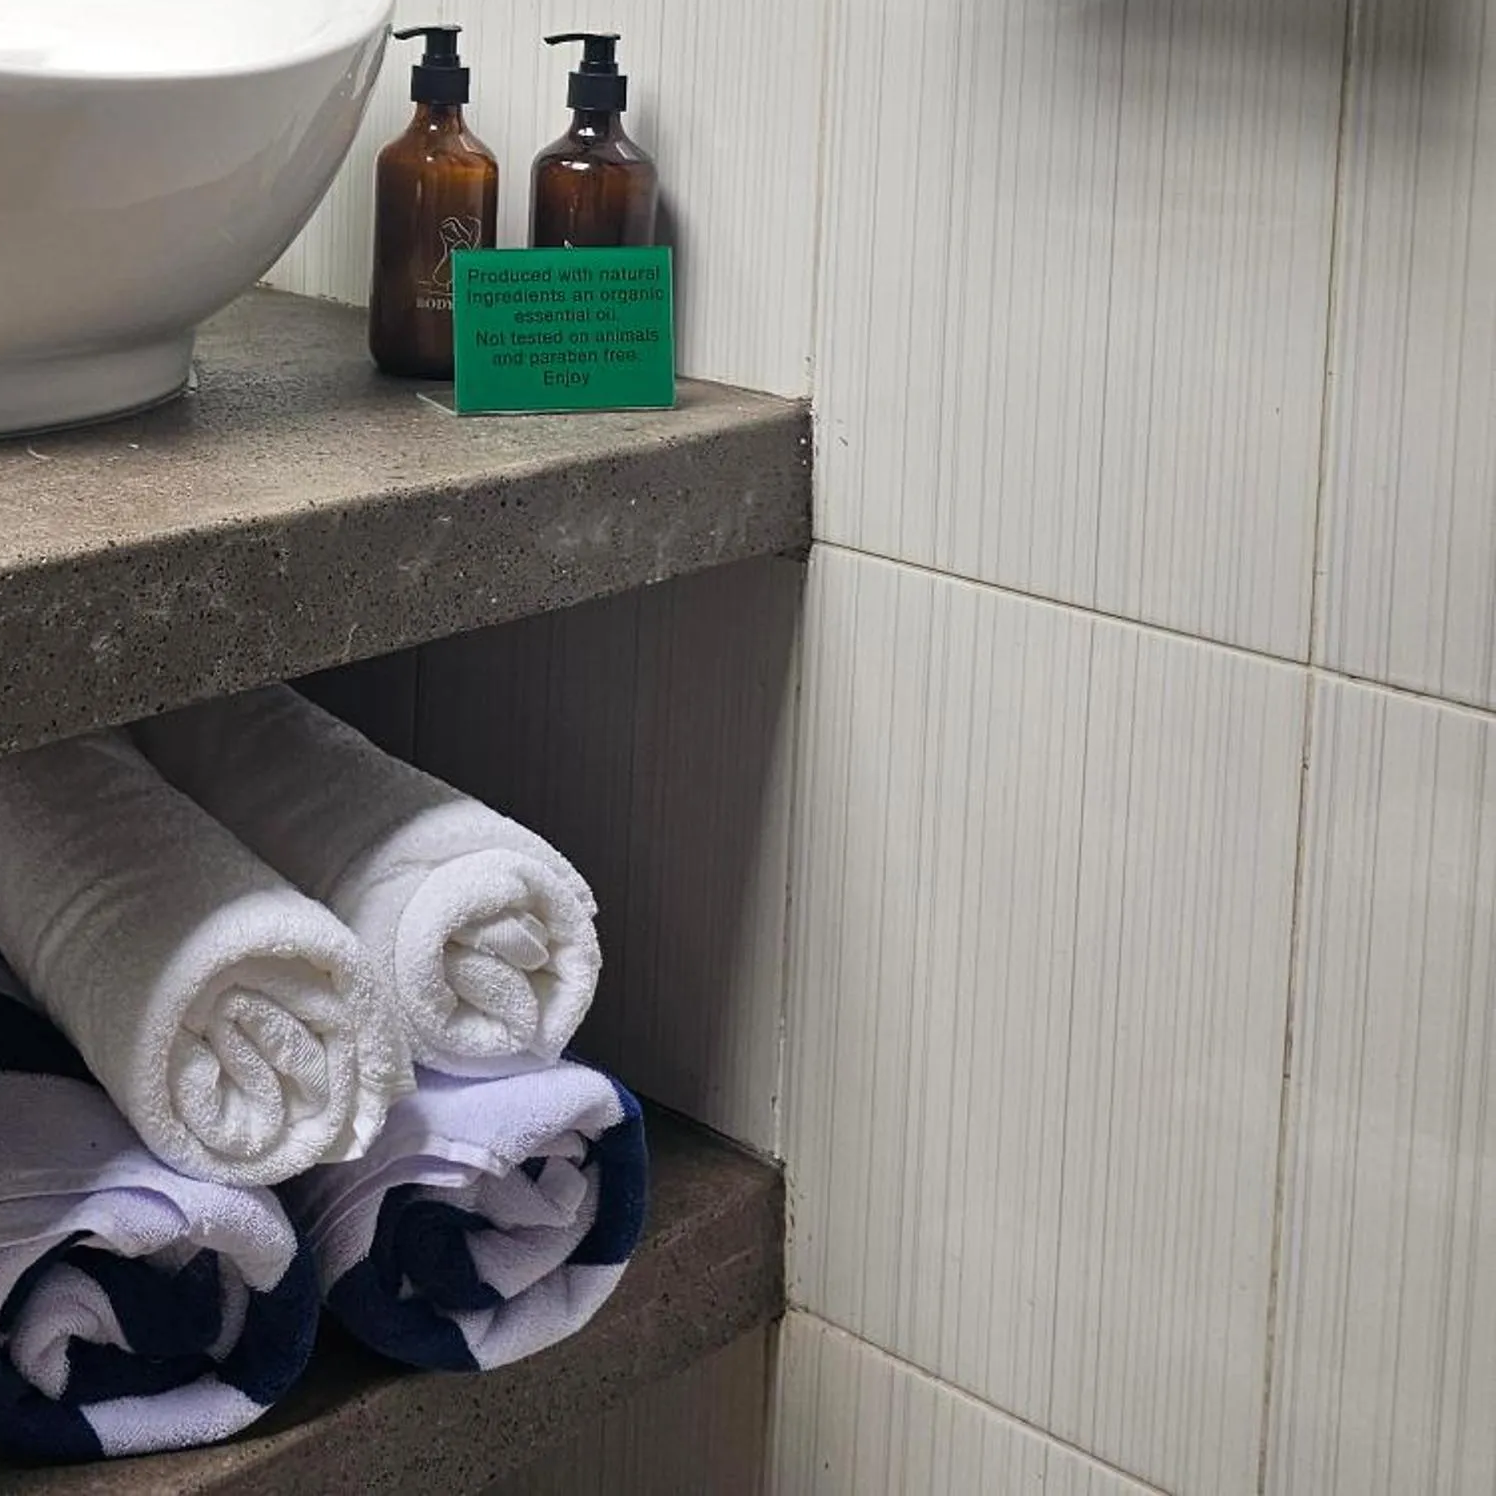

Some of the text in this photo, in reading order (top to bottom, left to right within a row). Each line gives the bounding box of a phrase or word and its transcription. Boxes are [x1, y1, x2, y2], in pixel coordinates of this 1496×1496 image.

[468, 268, 659, 283] Produced with natural
[600, 288, 664, 304] organic
[514, 309, 589, 323] essential
[476, 329, 659, 347] Not tested on animals
[493, 352, 523, 365] and
[530, 350, 598, 367] paraben
[544, 370, 590, 387] Enjoy
